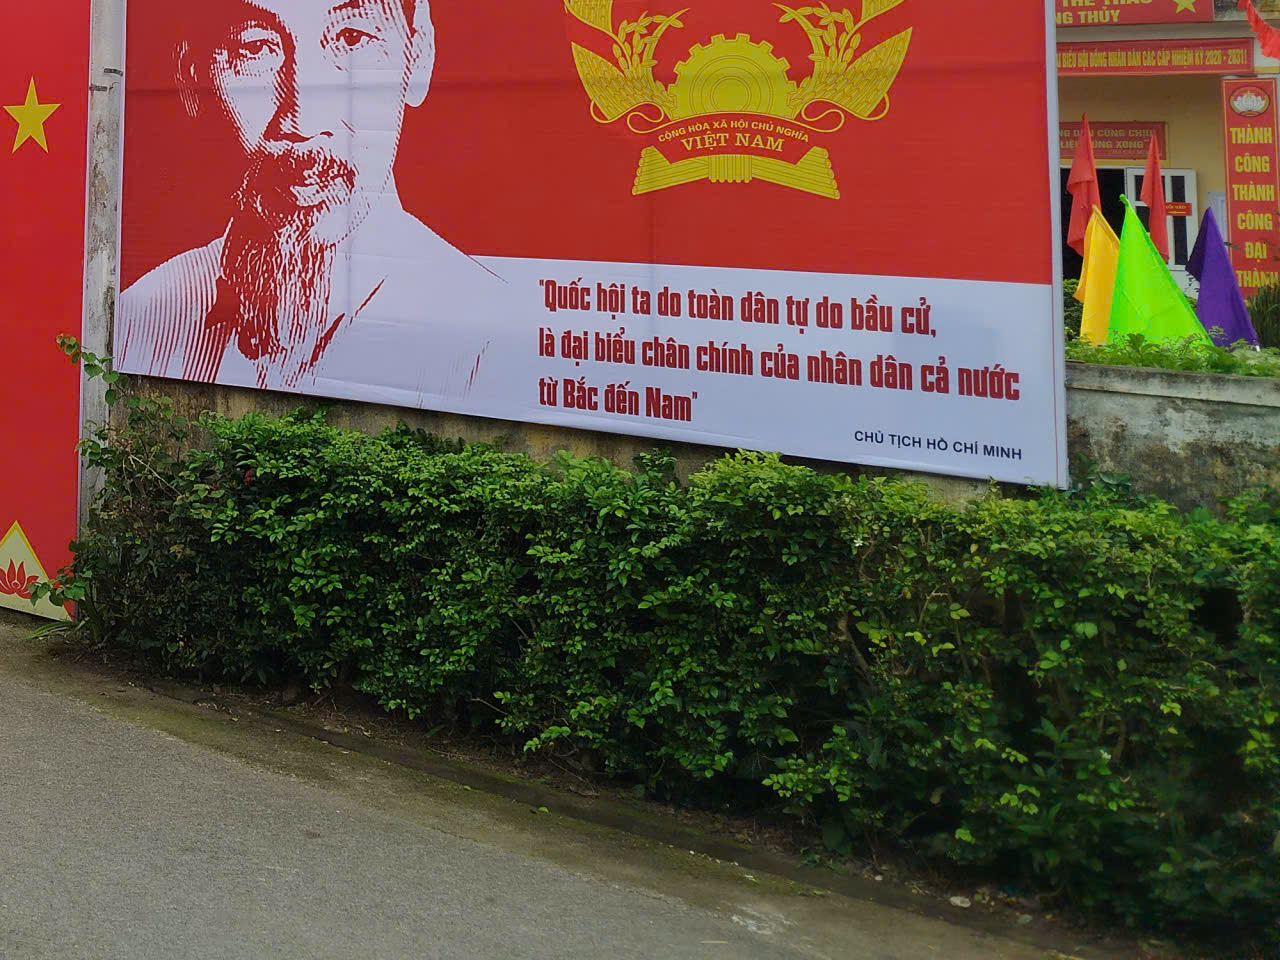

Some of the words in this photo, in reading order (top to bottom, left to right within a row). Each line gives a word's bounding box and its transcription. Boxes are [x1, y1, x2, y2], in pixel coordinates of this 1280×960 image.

[1078, 6, 1120, 23] THỦY
[681, 131, 729, 150] VIỆT
[735, 133, 785, 152] NAM
[1230, 124, 1272, 144] THÀNH
[1234, 153, 1270, 173] CÔNG
[1232, 181, 1275, 201] THÀNH
[1237, 210, 1273, 230] CÔNG
[1245, 241, 1267, 263] ĐẠI
[539, 277, 590, 312] "Quốc
[597, 282, 625, 320] hội
[631, 286, 651, 315] ta
[657, 286, 681, 317] do
[687, 288, 734, 320] toàn
[740, 291, 779, 325] dân
[785, 295, 810, 335] tự
[816, 296, 843, 329] do
[850, 293, 893, 333] bầu
[900, 296, 937, 338] cử,
[538, 327, 555, 357] là
[561, 330, 588, 366] đại
[595, 327, 635, 365] biểu
[642, 336, 690, 370] chân
[696, 340, 753, 376] chính
[760, 343, 800, 380] của
[807, 350, 862, 386] nhân
[870, 354, 913, 391] dân
[920, 355, 950, 394] cả
[958, 363, 1020, 401] nước
[538, 376, 558, 407] từ
[563, 376, 598, 411] Bắc
[604, 381, 639, 416] đến
[645, 386, 698, 422] Nam"
[854, 430, 884, 444] CHỦ
[888, 433, 922, 449] TỊCH
[952, 441, 978, 455] CHÍ
[983, 444, 1022, 460] MINH
